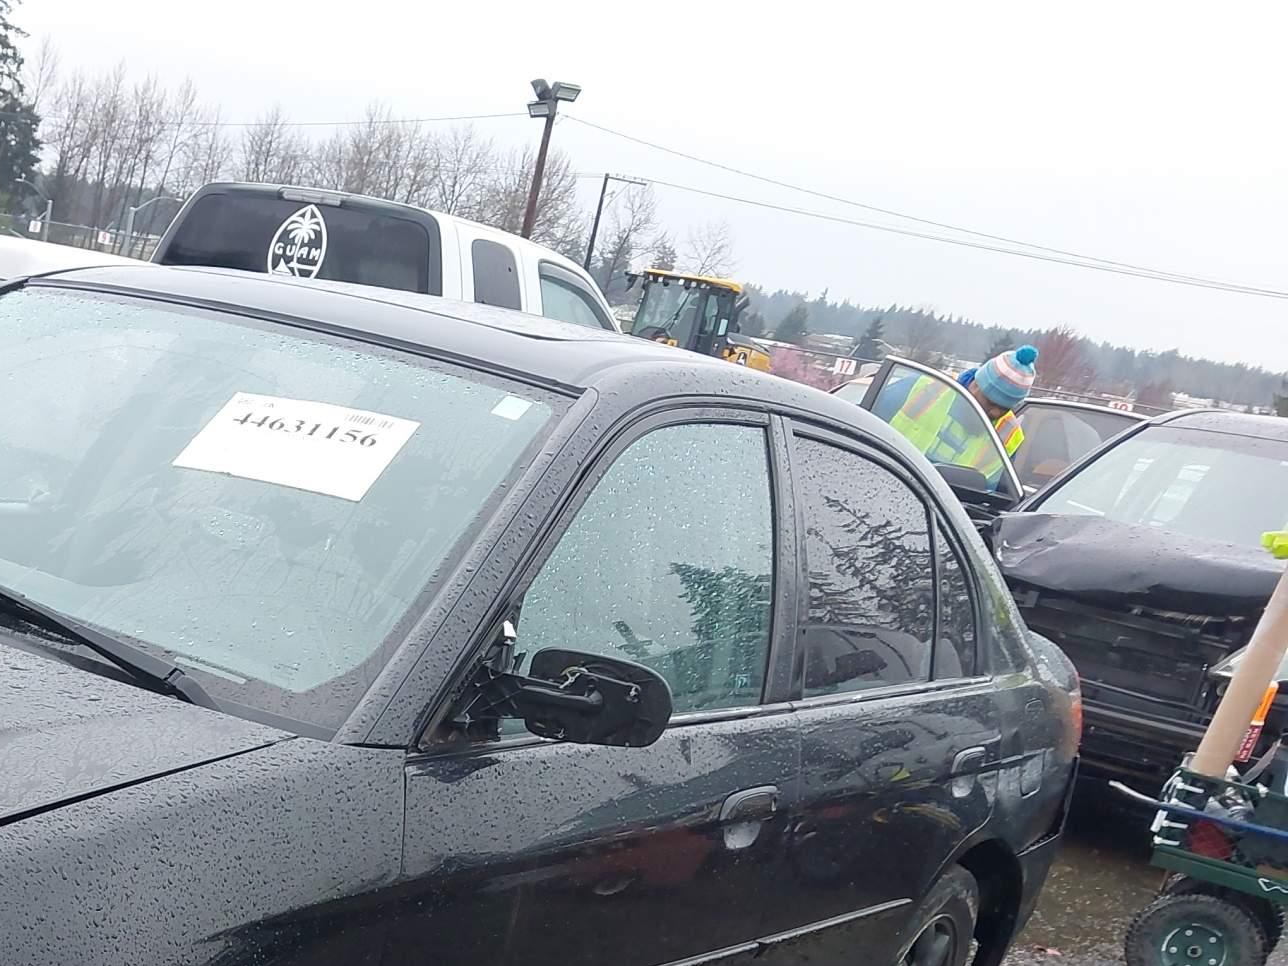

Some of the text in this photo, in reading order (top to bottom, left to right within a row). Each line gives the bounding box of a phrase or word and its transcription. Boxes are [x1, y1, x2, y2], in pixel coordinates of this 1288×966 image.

[274, 242, 321, 261] GUAM
[839, 359, 852, 374] 17
[232, 412, 378, 448] 44631156
